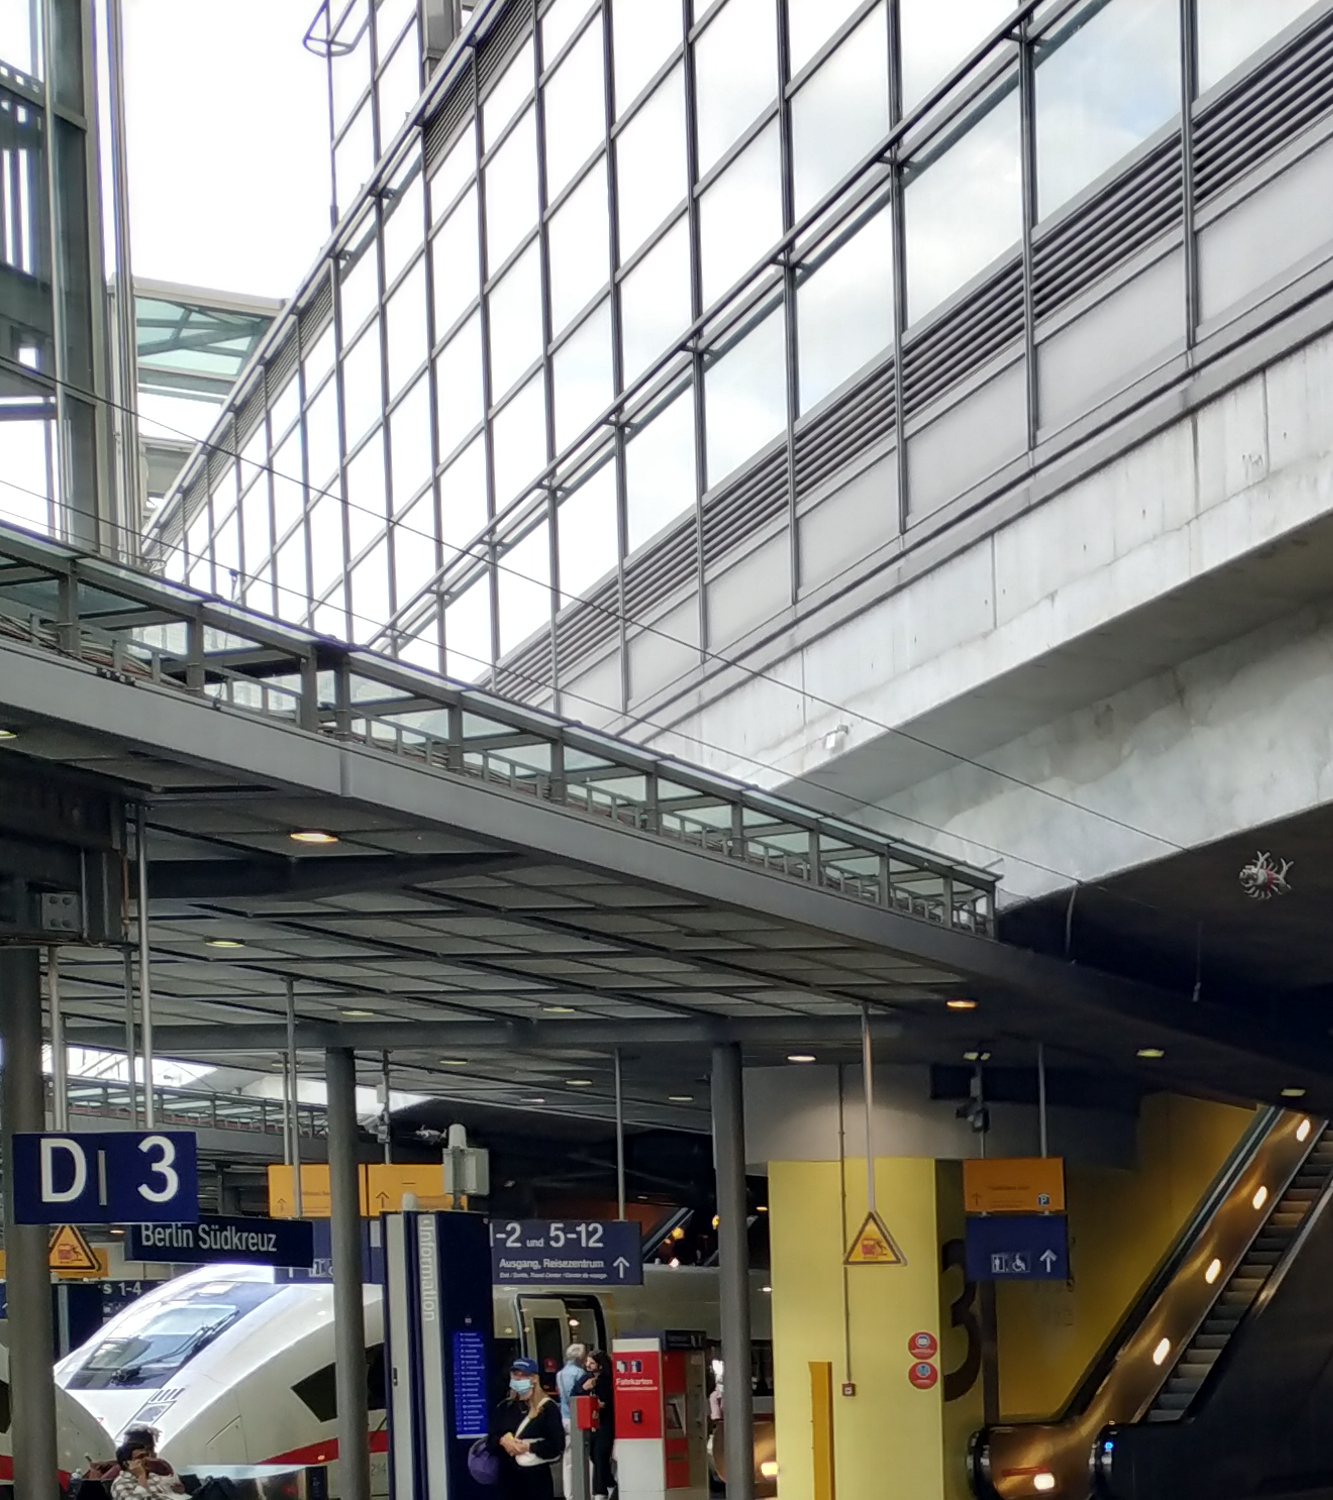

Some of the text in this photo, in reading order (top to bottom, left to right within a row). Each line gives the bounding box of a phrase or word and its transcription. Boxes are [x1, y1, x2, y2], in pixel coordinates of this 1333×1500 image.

[41, 1135, 179, 1203] D 3
[141, 1222, 278, 1252] Berlin Südkreuz
[526, 1237, 544, 1247] und
[550, 1223, 604, 1248] 5-12
[499, 1258, 604, 1270] Ausgang, Reisezentrum
